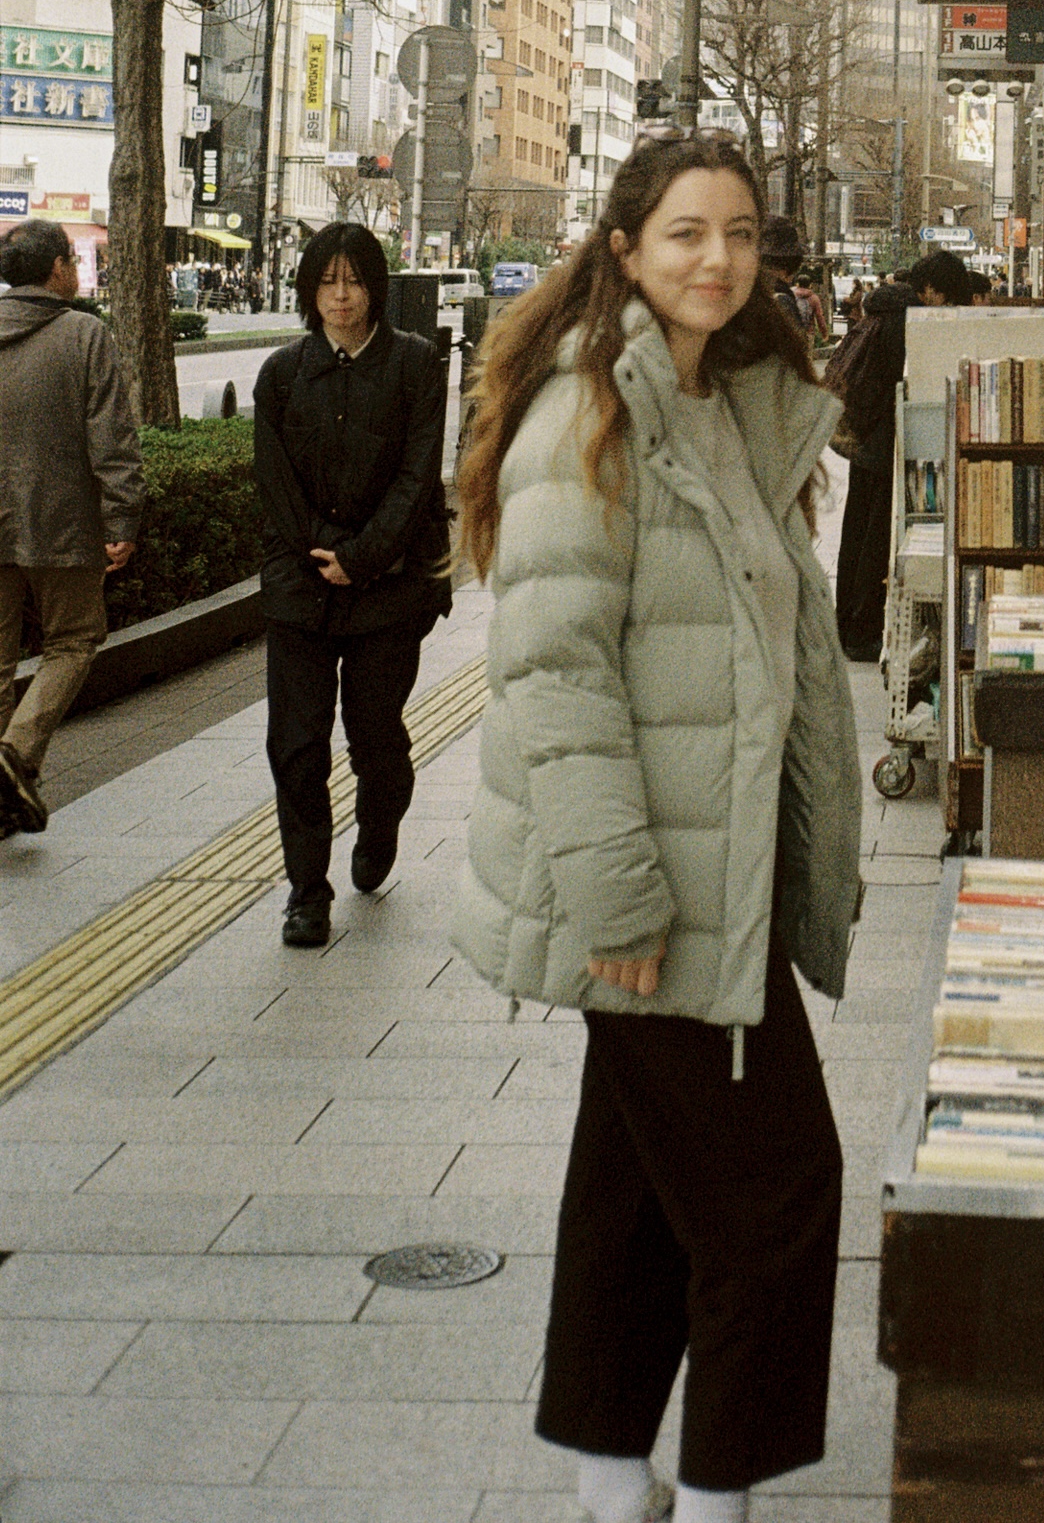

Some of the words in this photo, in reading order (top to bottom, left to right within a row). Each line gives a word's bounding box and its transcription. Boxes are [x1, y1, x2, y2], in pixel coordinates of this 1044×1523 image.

[0, 30, 111, 71] 社文庫
[0, 78, 110, 118] 社新書
